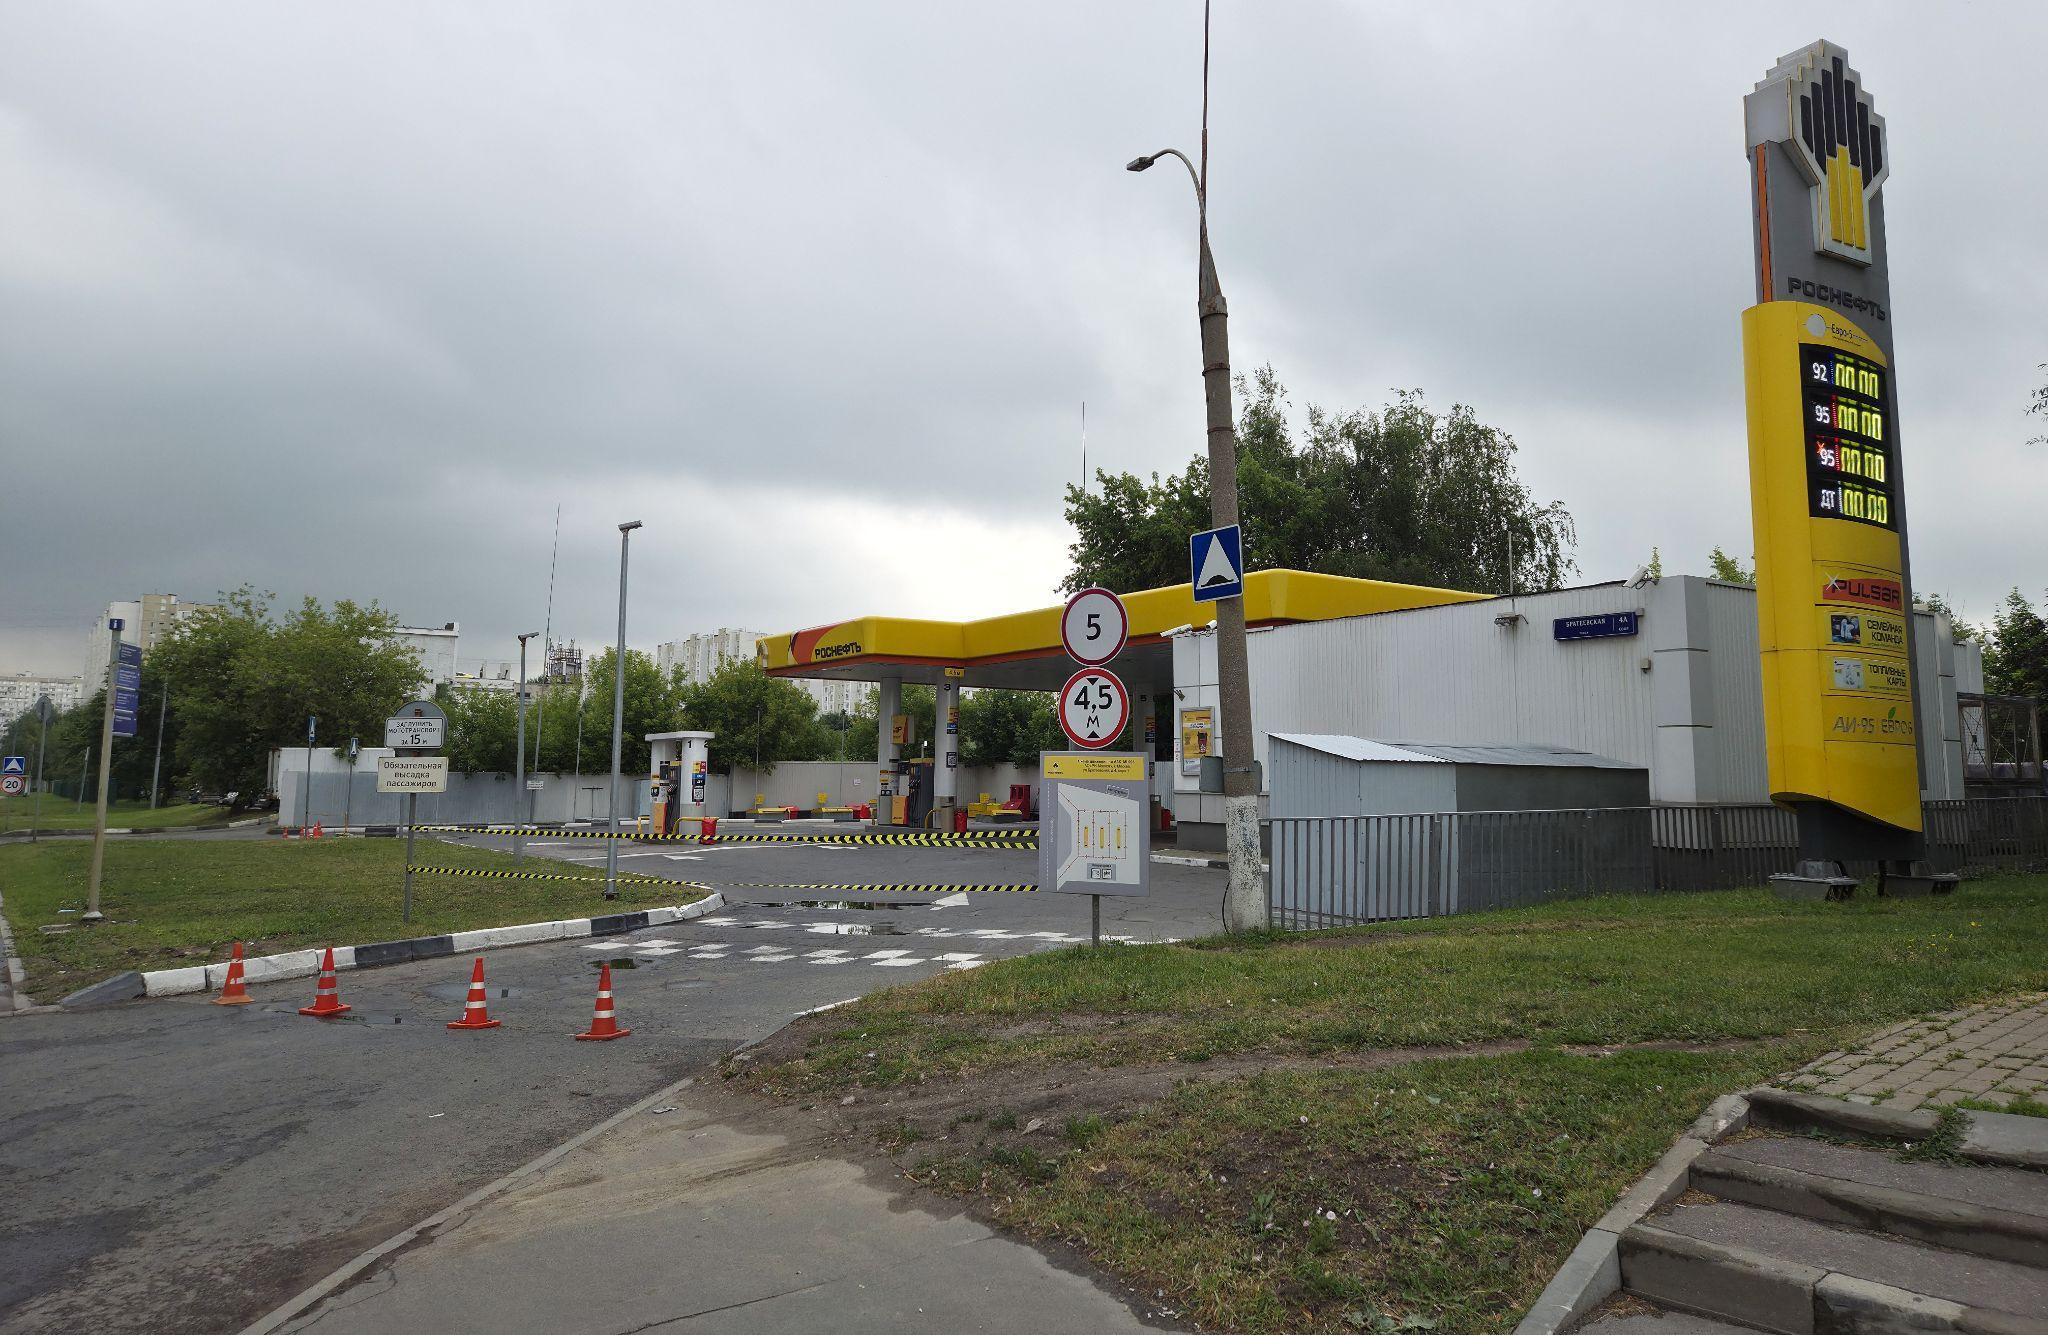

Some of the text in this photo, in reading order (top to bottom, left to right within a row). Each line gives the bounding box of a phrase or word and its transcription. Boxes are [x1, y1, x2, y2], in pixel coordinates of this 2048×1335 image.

[1787, 276, 1886, 321] РОСНЕФТЬ
[1812, 362, 1828, 382] 92
[1815, 404, 1831, 424] 95
[1819, 448, 1835, 468] 95
[1086, 613, 1102, 641] 5
[815, 642, 862, 660] РОСНЕФТЬ
[1073, 684, 1114, 713] 4,5
[410, 734, 421, 745] 15
[383, 761, 442, 770] Обязательная
[5, 780, 19, 789] 20
